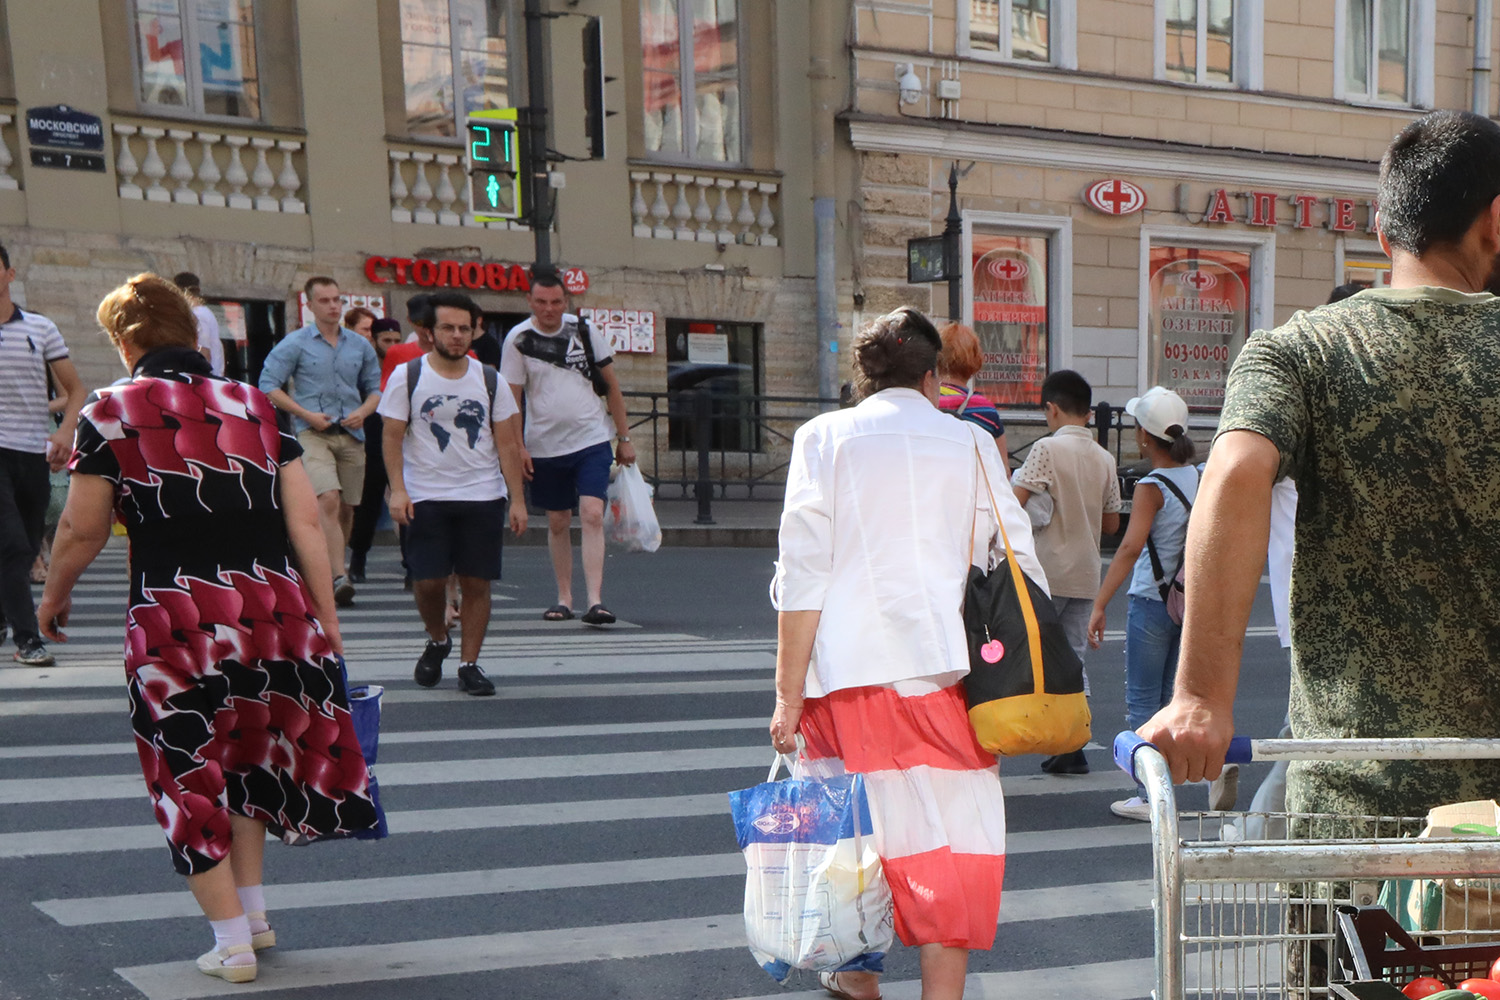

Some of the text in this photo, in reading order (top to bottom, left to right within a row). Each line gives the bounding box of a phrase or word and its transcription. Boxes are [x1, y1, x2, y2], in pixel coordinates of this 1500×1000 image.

[30, 118, 100, 135] МОСКОВСКИЙ
[472, 126, 509, 162] 21
[65, 154, 72, 167] 7
[1208, 188, 1379, 232] АПТЕ
[365, 256, 532, 291] СТОЛОВА
[567, 270, 585, 284] 24
[979, 290, 1038, 304] АПТЕКА
[1162, 297, 1234, 314] АПТЕКА
[979, 311, 1040, 325] ОЗЕРКИ
[1162, 317, 1233, 334] ОЗЕРКИ
[984, 353, 1042, 365] ОНСУЛЬТАЦИИ
